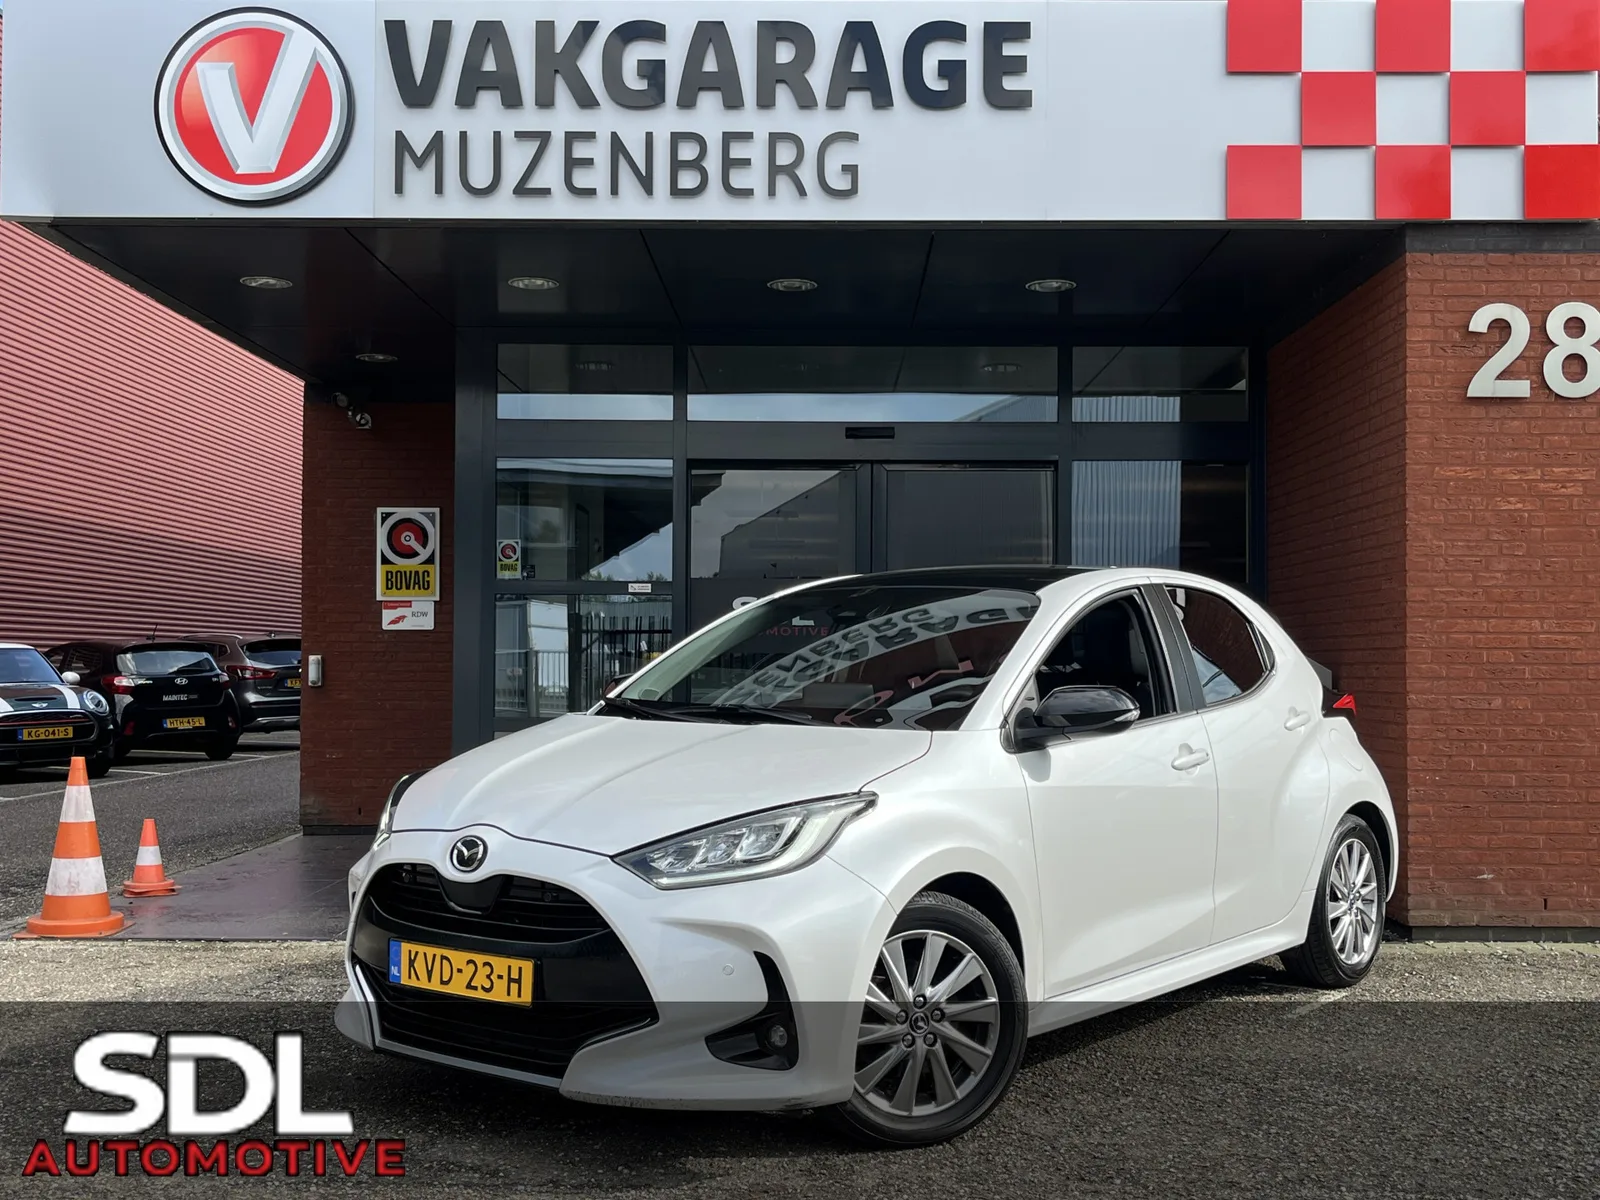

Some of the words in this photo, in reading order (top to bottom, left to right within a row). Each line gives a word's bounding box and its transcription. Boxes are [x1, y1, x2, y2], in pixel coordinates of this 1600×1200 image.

[384, 20, 1033, 110] VAKGARAGE
[197, 28, 316, 174] V
[394, 131, 859, 197] MUZENBERG
[1467, 302, 1600, 398] 28
[386, 570, 430, 591] BOVAG
[500, 563, 518, 572] BOVAG
[765, 626, 829, 636] MOTIVE
[27, 728, 69, 738] KG-041-S
[168, 717, 204, 727] HTH-45-L
[391, 966, 400, 976] NL
[407, 949, 523, 998] KVD-23-H
